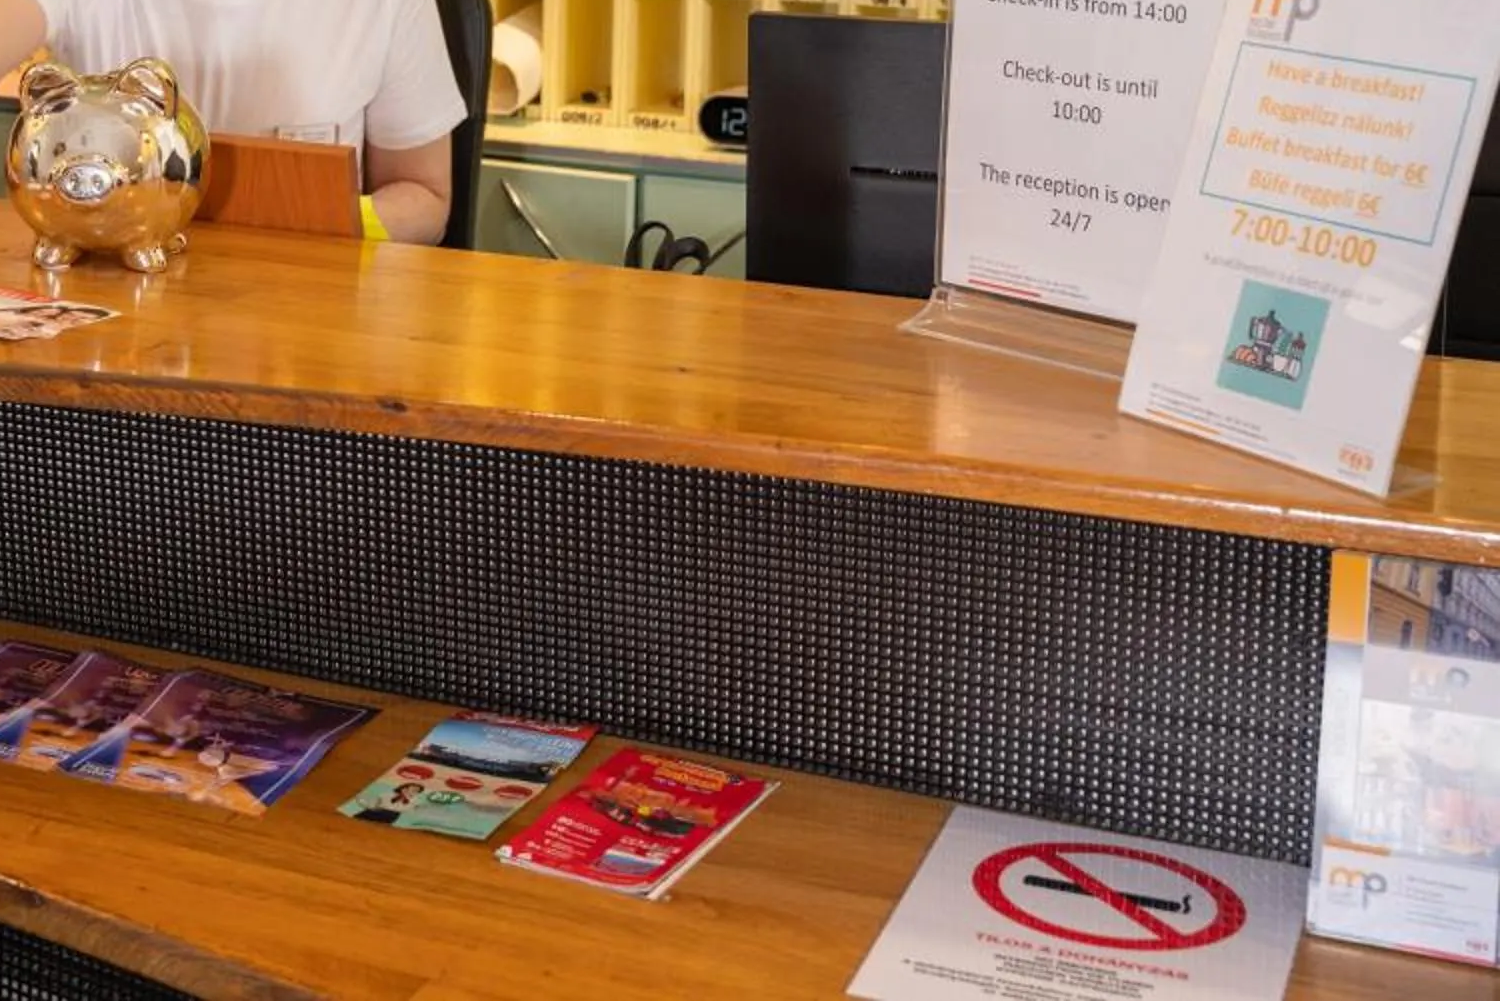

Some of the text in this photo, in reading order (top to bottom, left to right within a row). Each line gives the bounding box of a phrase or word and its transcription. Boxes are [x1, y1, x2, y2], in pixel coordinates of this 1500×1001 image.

[1133, 0, 1187, 24] 14:00
[1002, 60, 1159, 99] Check-out is until
[1266, 59, 1313, 85] Have
[1331, 68, 1426, 102] breakfast!
[1052, 100, 1102, 124] 10:00
[1225, 126, 1429, 186] Buffet breakfast for 6€
[979, 162, 1011, 185] The
[1015, 173, 1100, 201] reception
[1104, 185, 1119, 204] is
[1049, 207, 1093, 232] 24/7
[1356, 193, 1383, 217] 6€
[1231, 208, 1377, 268] 7:00-10:00
